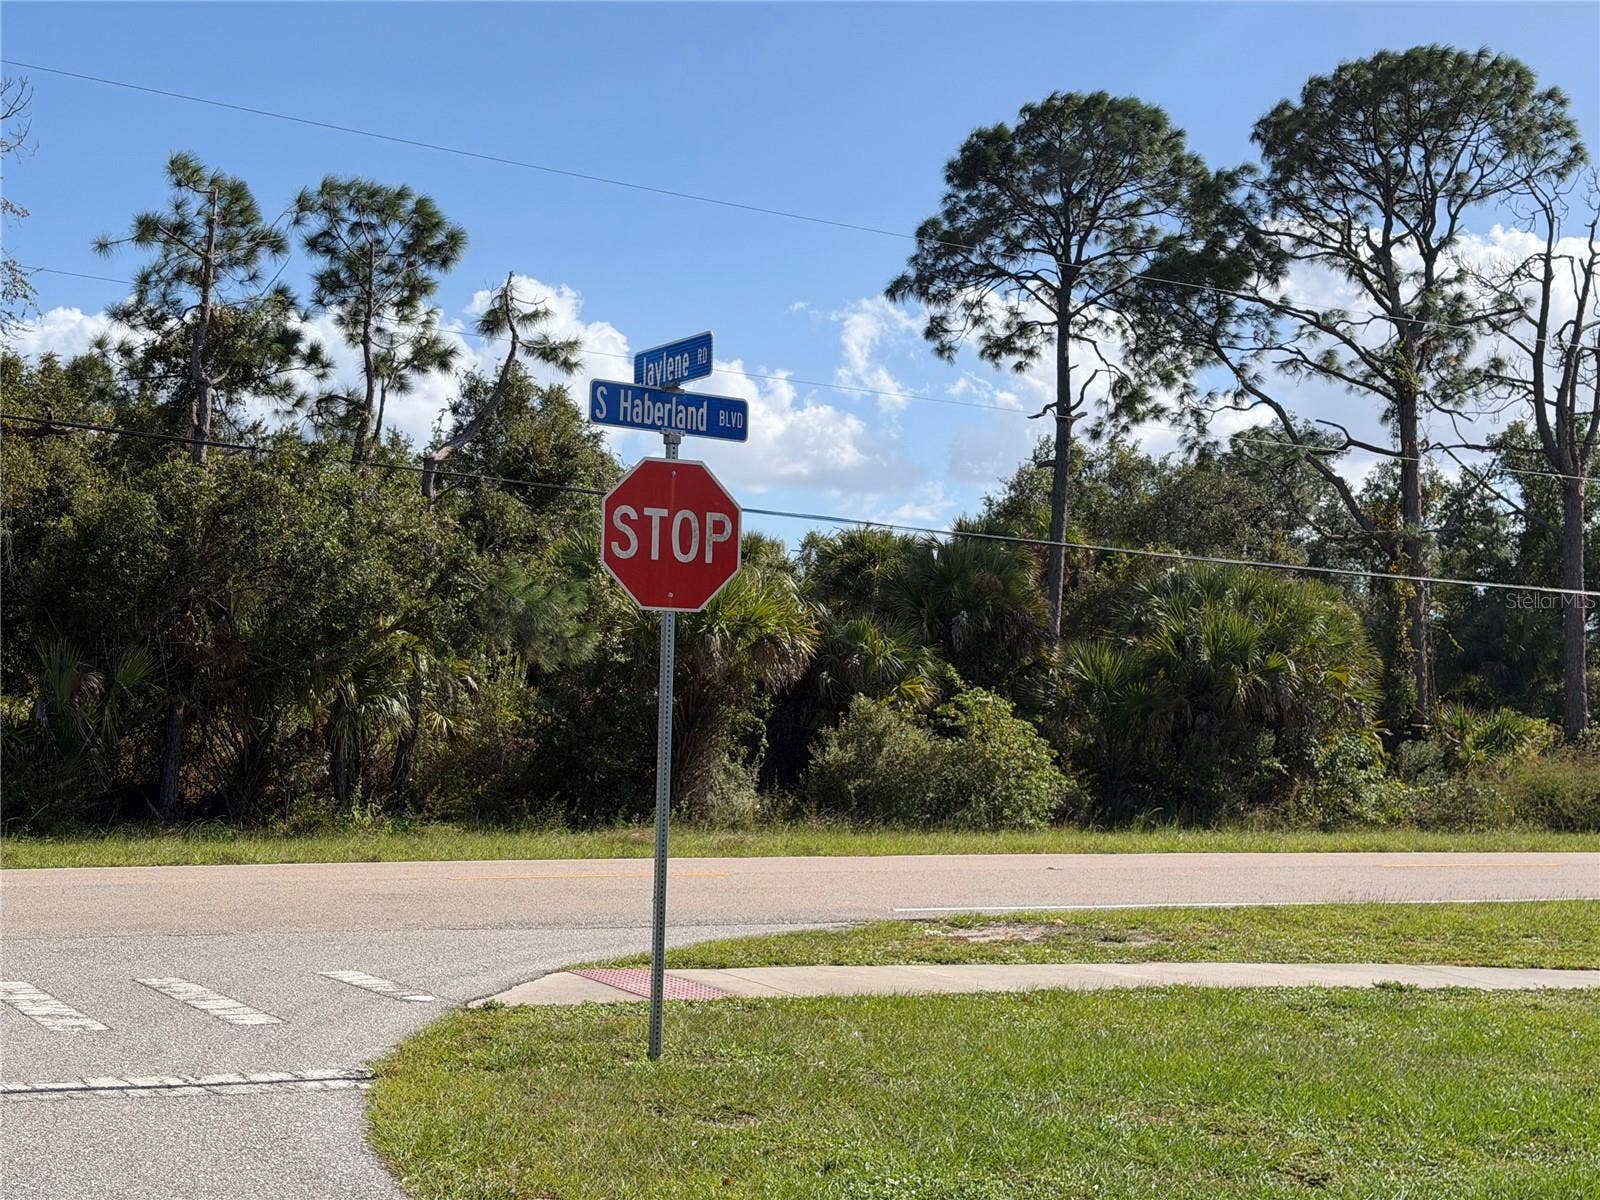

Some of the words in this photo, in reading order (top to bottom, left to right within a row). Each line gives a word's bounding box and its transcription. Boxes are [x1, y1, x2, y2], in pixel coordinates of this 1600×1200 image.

[639, 351, 690, 388] Jaylene
[697, 347, 708, 365] RD
[595, 385, 608, 419] S
[619, 389, 708, 432] Haberland
[719, 410, 743, 429] BLVD
[610, 504, 733, 564] STOP
